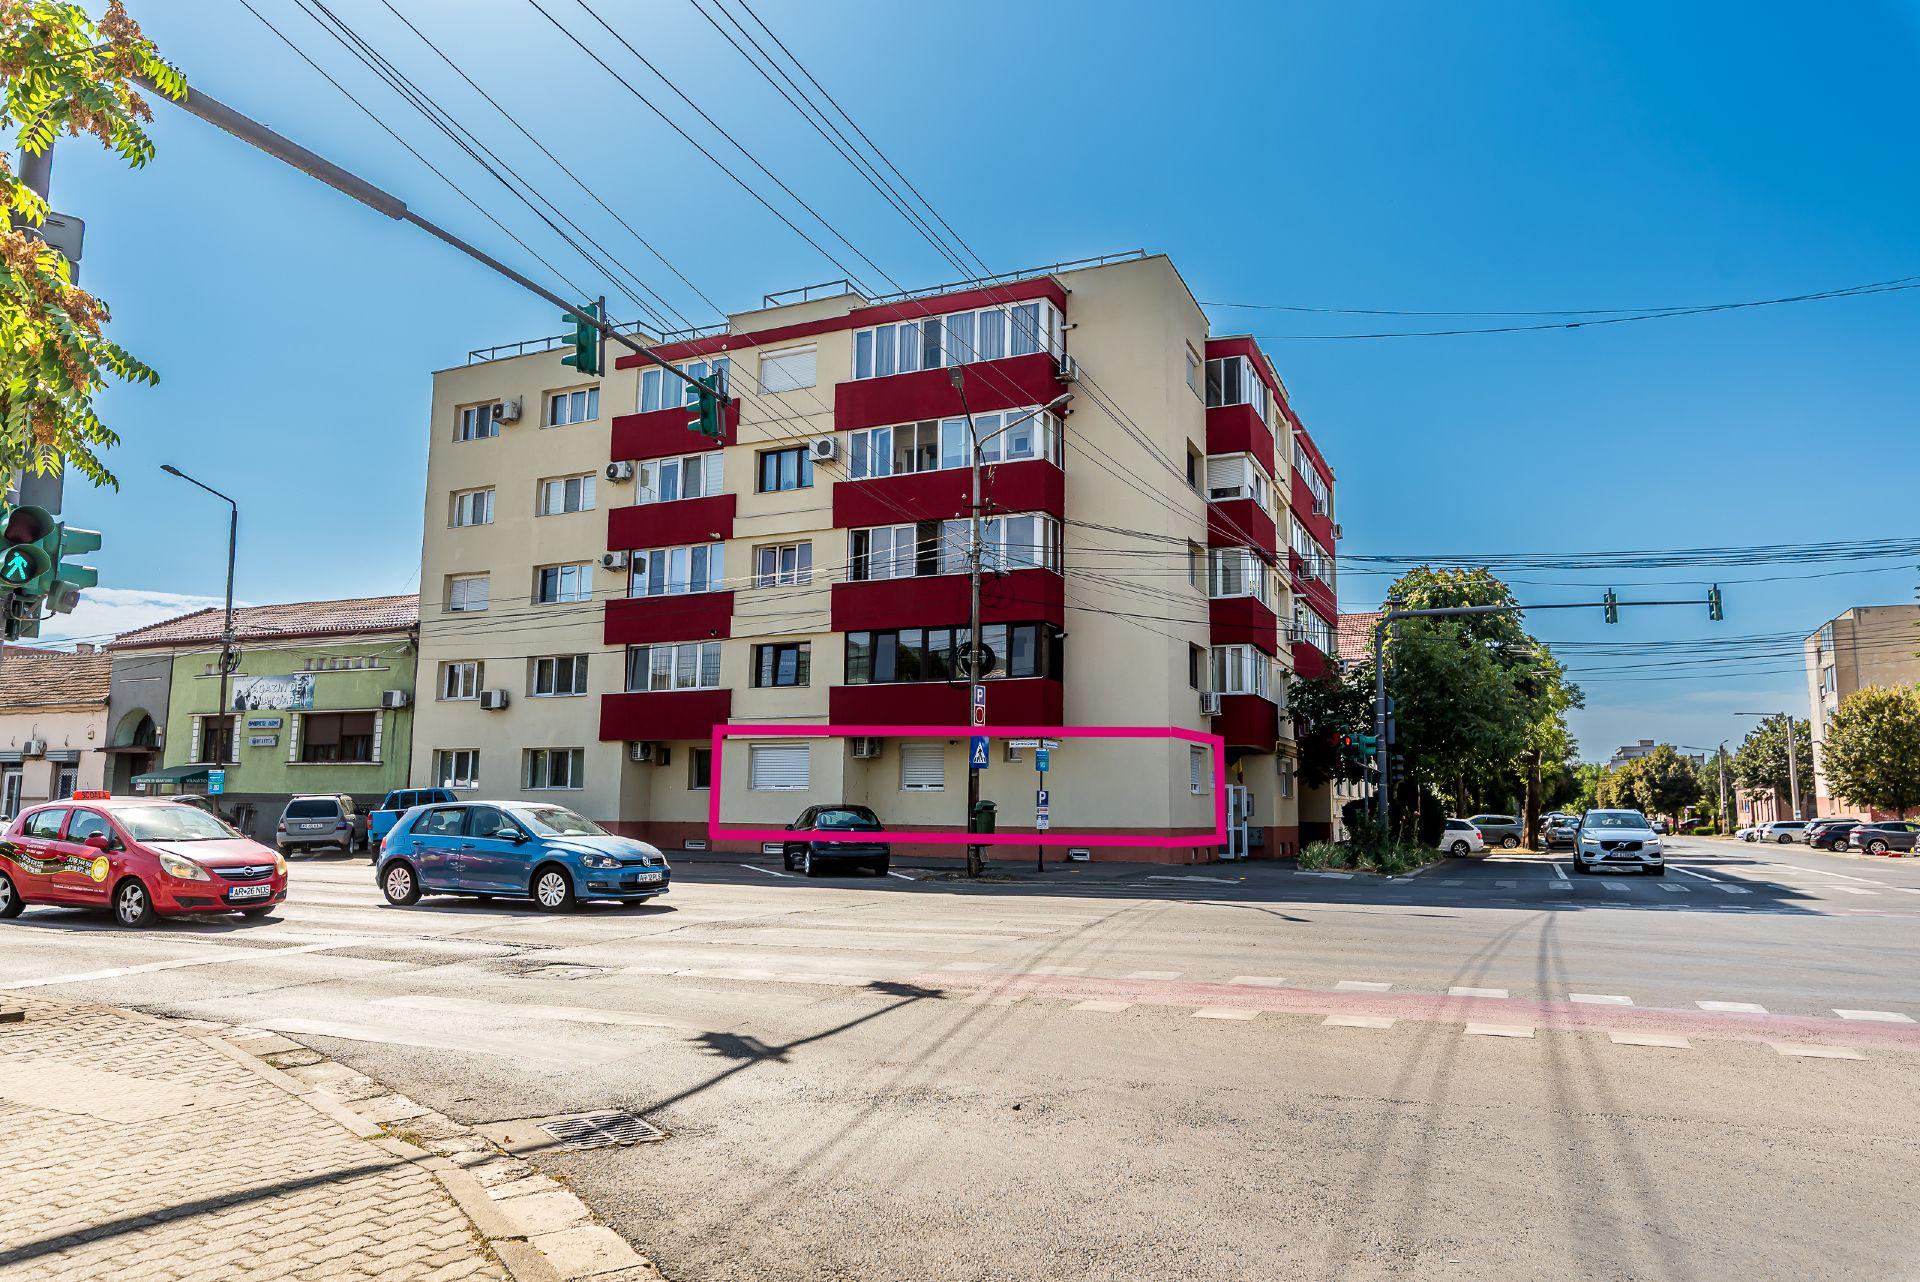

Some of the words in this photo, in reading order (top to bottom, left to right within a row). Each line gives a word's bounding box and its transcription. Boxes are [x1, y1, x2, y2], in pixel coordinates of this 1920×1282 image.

[290, 681, 302, 693] DE
[977, 688, 984, 702] P
[1039, 791, 1046, 804] P
